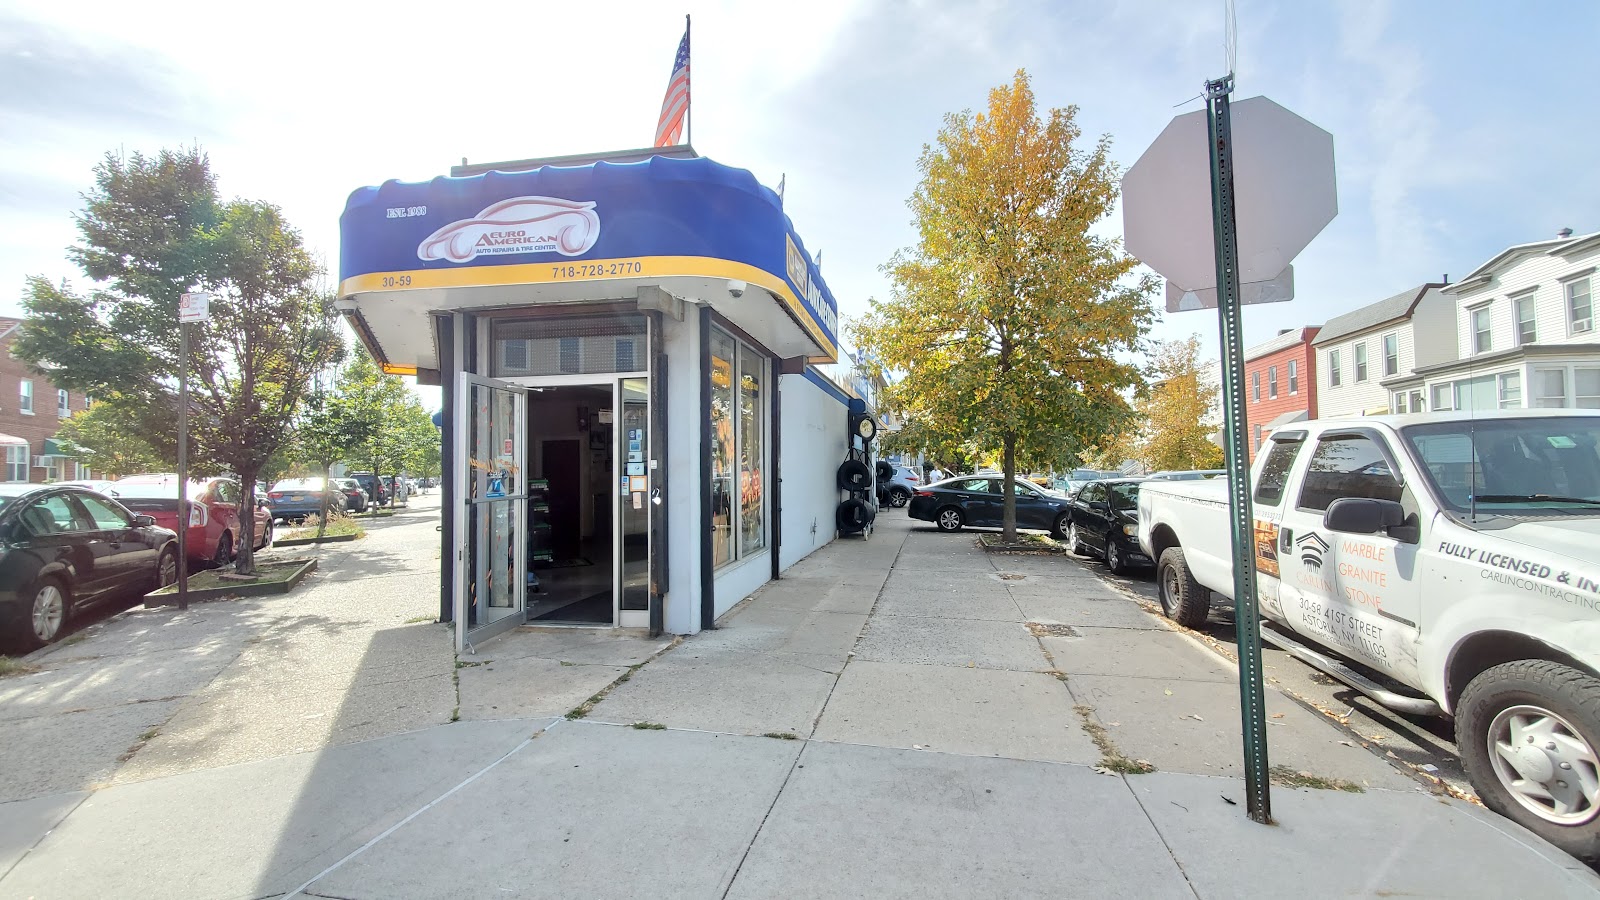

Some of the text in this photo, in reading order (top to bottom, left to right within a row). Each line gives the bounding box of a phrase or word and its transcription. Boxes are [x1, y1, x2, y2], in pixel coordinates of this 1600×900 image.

[475, 233, 558, 247] AMERICAN
[490, 230, 526, 239] EURO
[552, 261, 642, 278] 718-728-2770
[382, 275, 412, 287] 30-59
[1342, 540, 1386, 562] MARBLE
[1339, 563, 1387, 588] GRANITE
[1438, 541, 1600, 594] FULLY LICENSED & IN
[1296, 571, 1333, 593] CARLIN
[1345, 586, 1384, 611] STONE
[1299, 597, 1322, 616] 30-58
[1324, 607, 1346, 626] 41ST
[1348, 616, 1383, 641] STREET
[1302, 612, 1341, 640] ASTORIA,
[1341, 630, 1355, 646] NY
[1358, 636, 1387, 658] 11103
